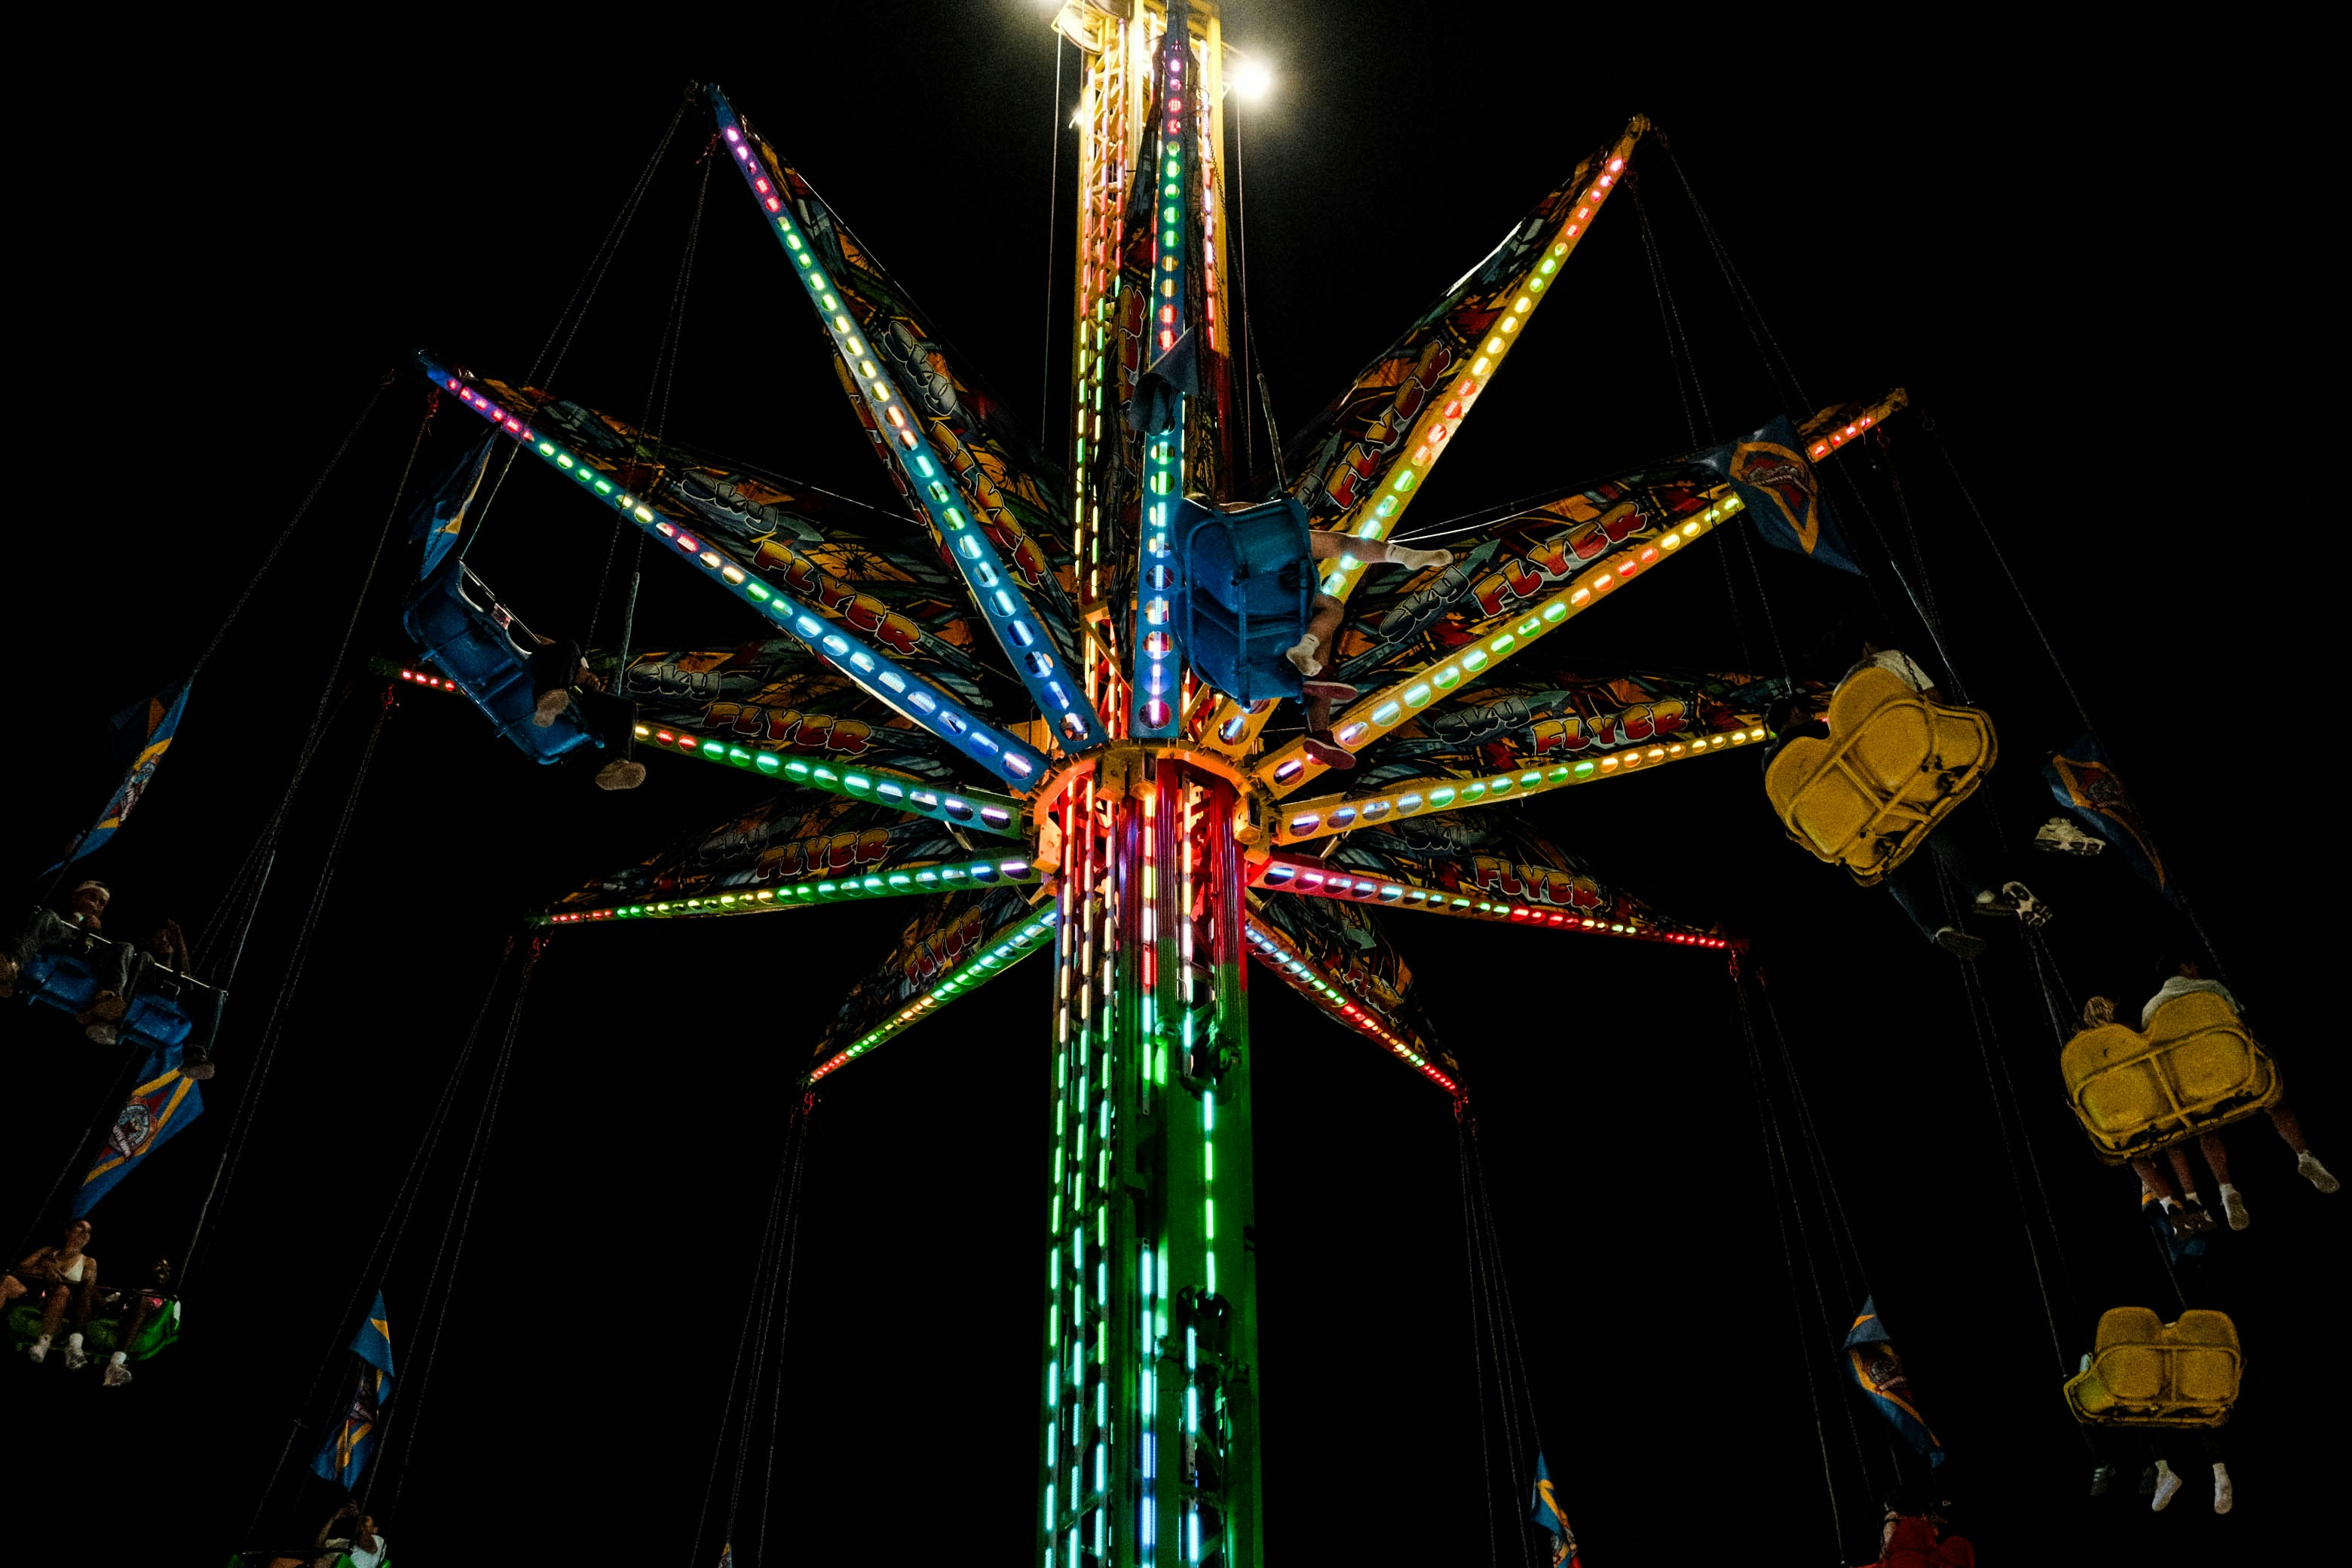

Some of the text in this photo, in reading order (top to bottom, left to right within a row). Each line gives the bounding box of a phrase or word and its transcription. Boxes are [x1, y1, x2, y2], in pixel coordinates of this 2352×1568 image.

[1325, 339, 1451, 510] FLYER
[929, 419, 1046, 586] FLYER
[753, 538, 922, 655] FLYER
[1472, 501, 1647, 617] FLYER
[701, 701, 873, 755] FLYER
[1530, 698, 1688, 755] FLYER
[756, 827, 890, 879] FLYER
[1471, 855, 1604, 911] FLYER
[903, 905, 982, 988] FLYER
